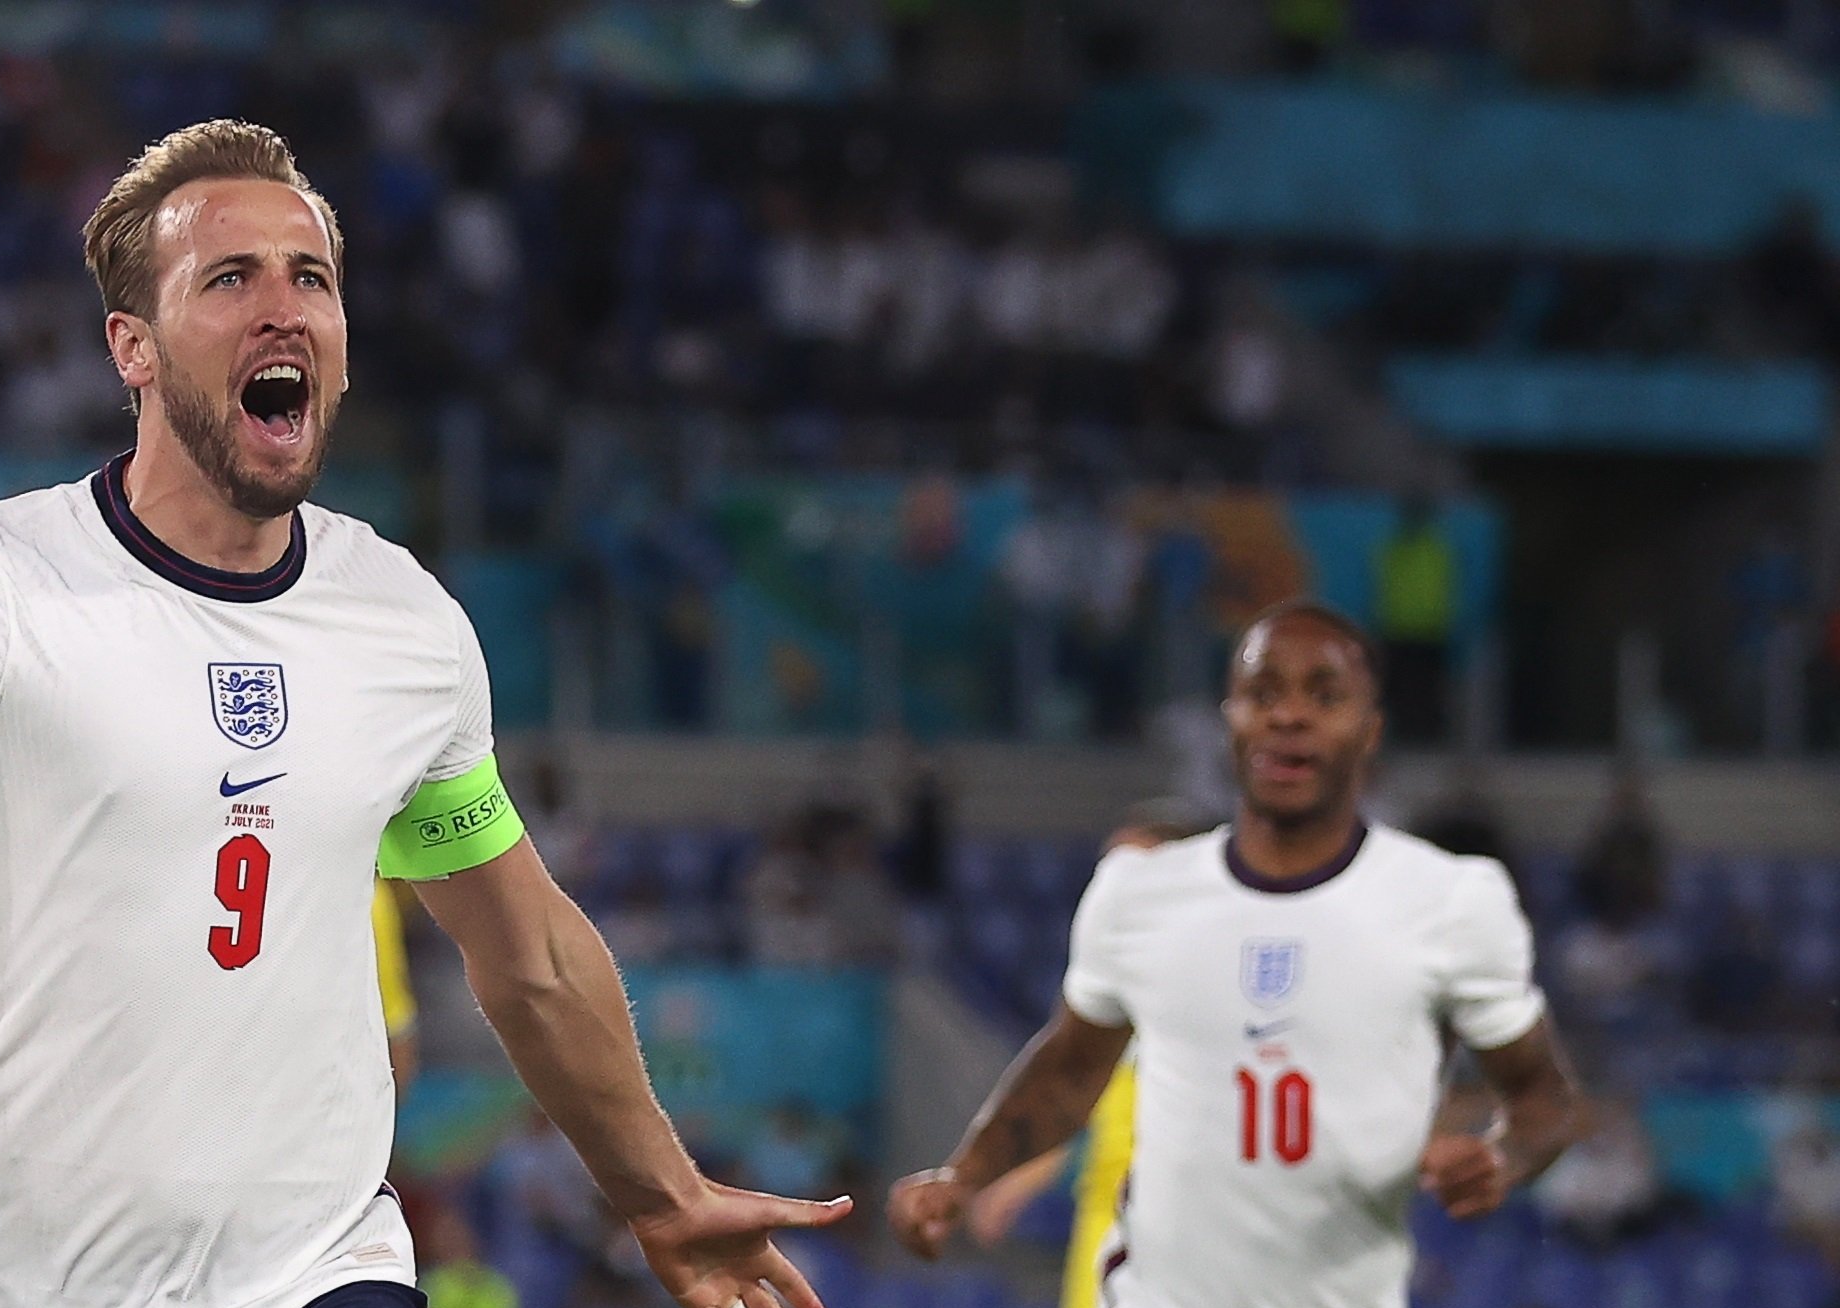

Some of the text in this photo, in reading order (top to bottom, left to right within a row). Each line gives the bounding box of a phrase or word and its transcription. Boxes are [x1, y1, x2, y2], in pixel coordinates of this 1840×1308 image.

[231, 803, 271, 816] UKRAINE
[231, 816, 253, 828] JULY
[207, 833, 271, 971] 9
[1235, 1065, 1313, 1165] 10
